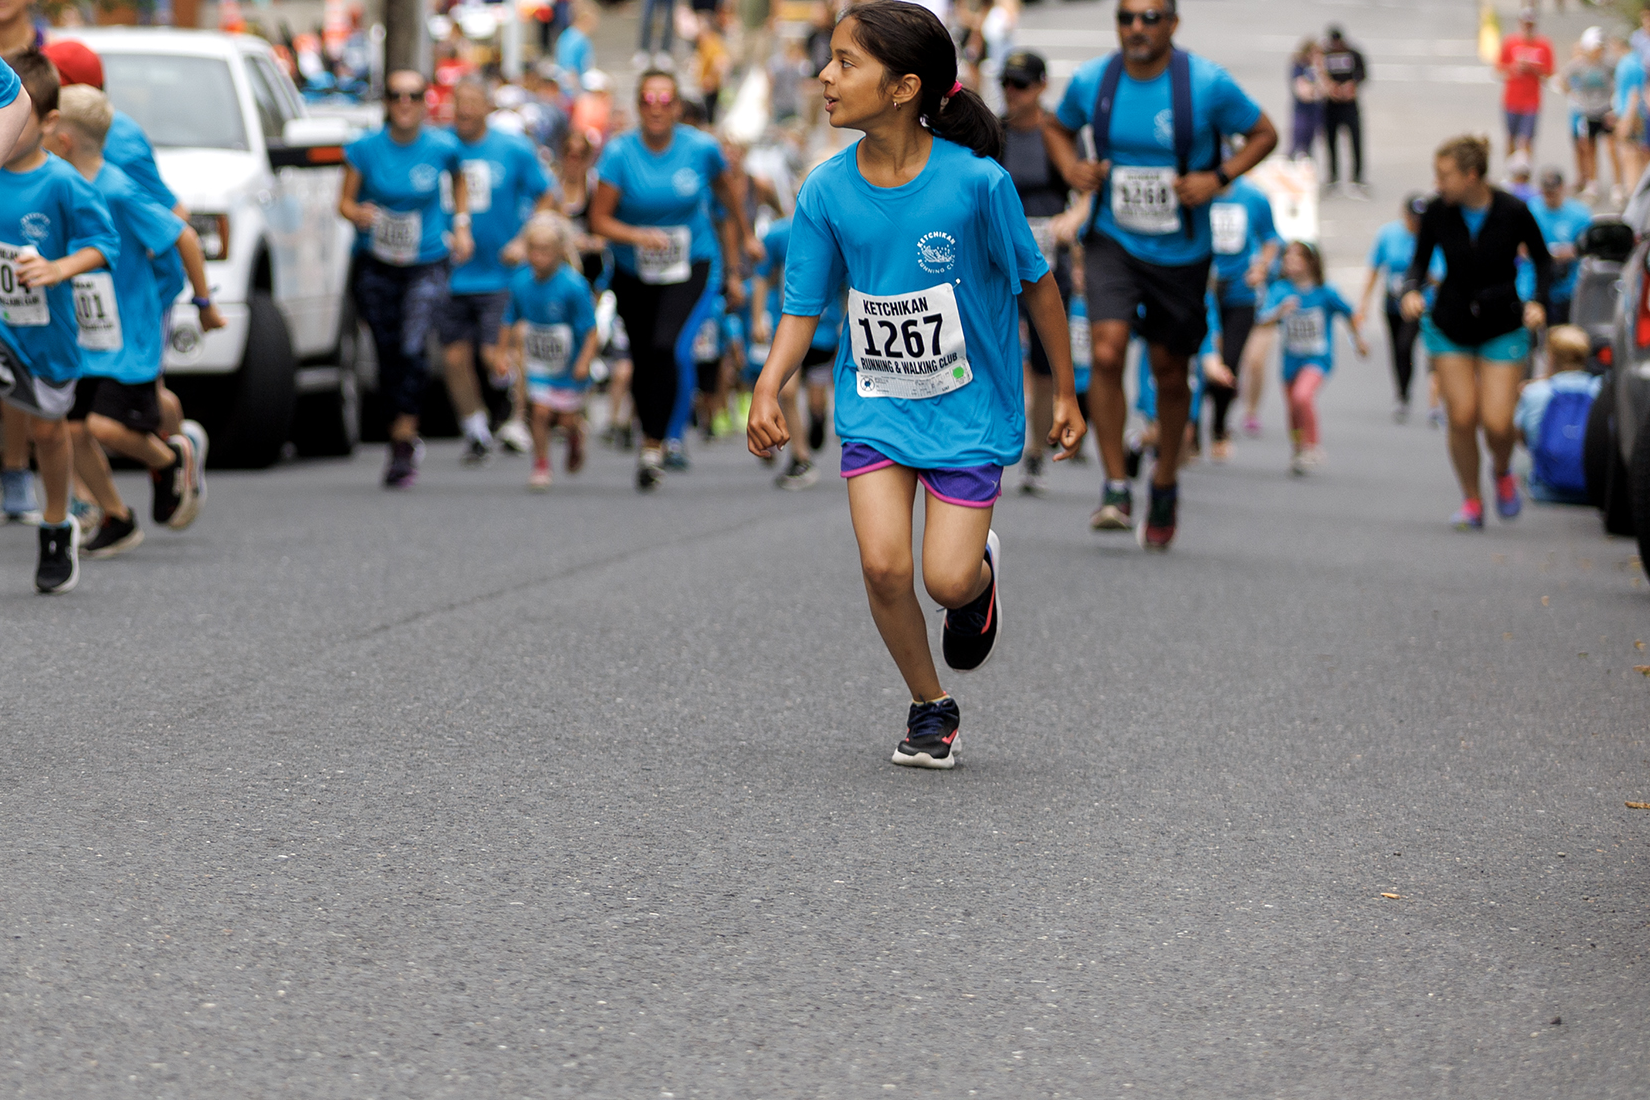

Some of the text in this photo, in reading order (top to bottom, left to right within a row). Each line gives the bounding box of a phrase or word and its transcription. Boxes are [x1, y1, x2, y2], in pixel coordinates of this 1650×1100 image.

[917, 231, 956, 248] KETCHIKAN
[918, 259, 945, 274] RUNNING
[862, 296, 929, 317] KETCHIKAN
[858, 313, 944, 359] 1267
[860, 352, 958, 375] RUNNING & WALKING CLUB
